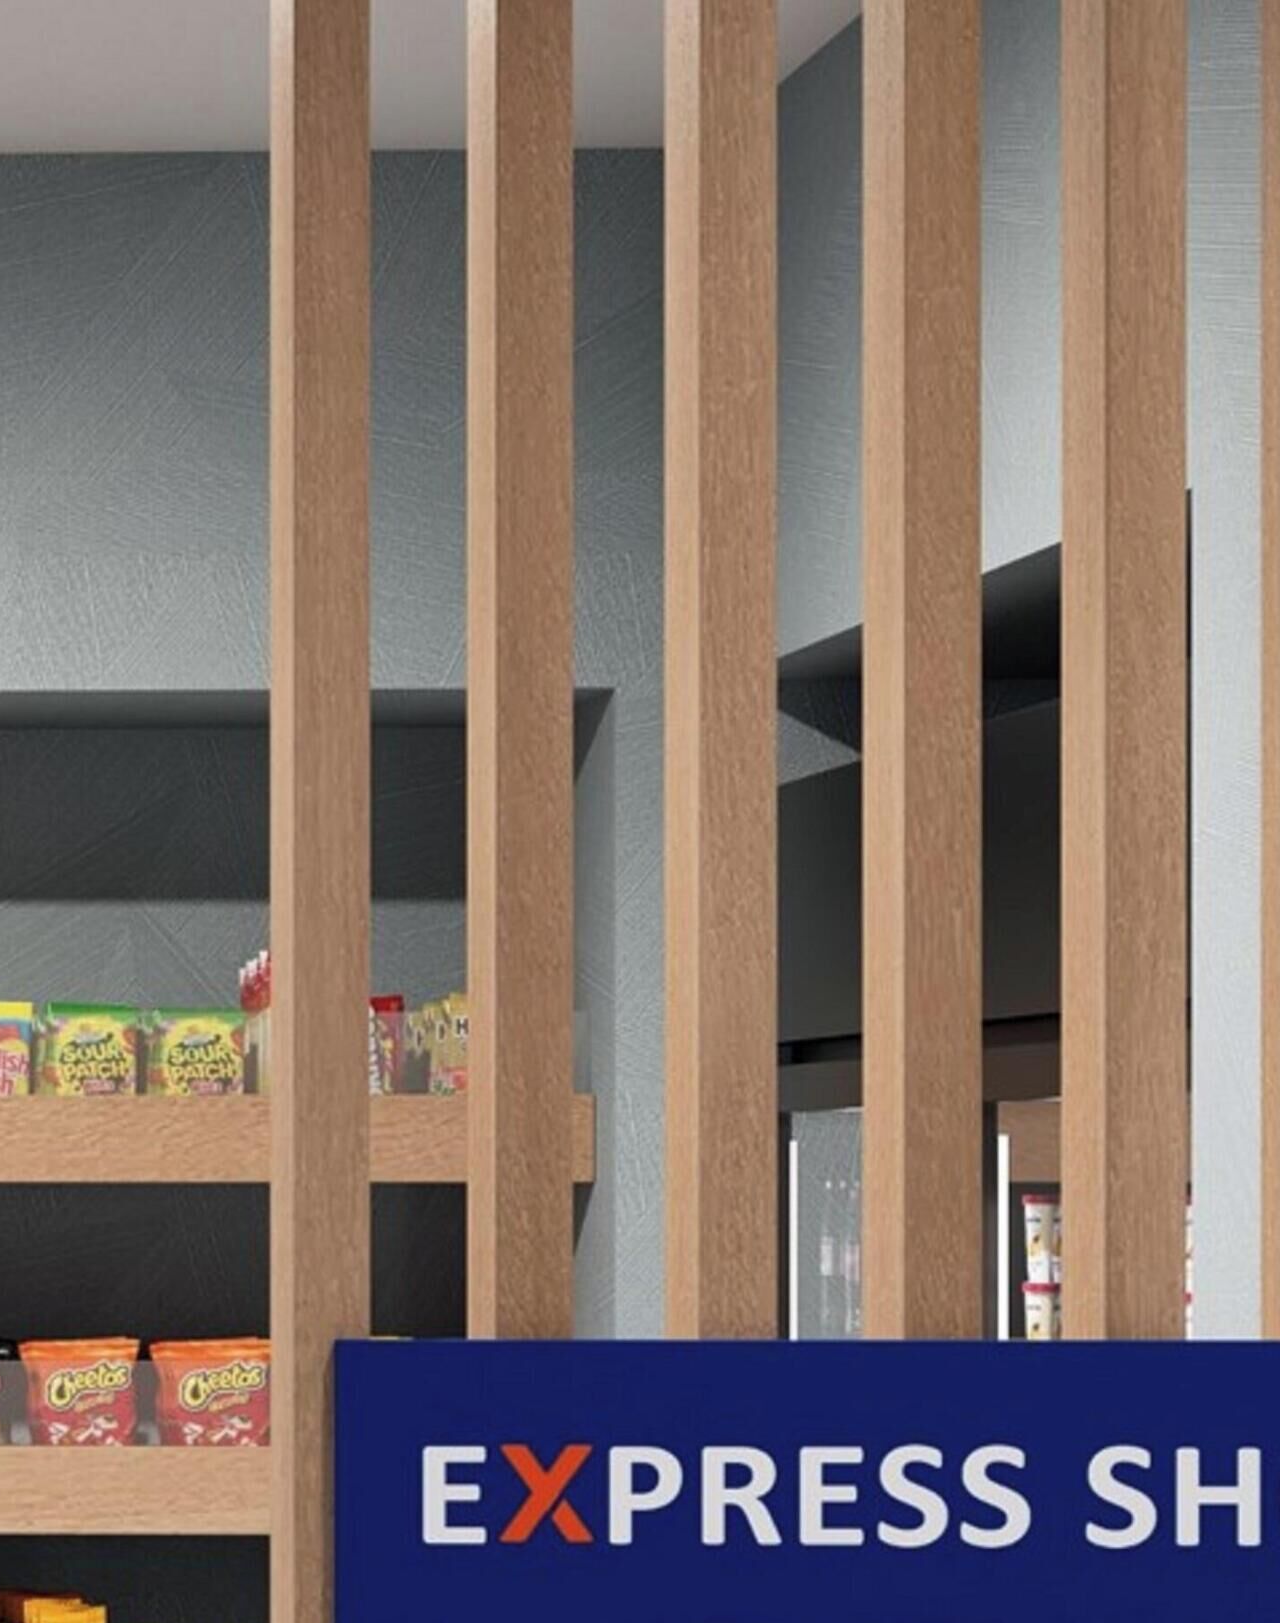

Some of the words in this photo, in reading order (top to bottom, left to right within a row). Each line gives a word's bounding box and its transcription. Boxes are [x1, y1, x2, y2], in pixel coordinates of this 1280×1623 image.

[47, 1363, 130, 1409] Cheetos
[182, 1363, 265, 1409] Cheetos
[421, 1444, 1032, 1547] EXPRESS
[1084, 1444, 1262, 1547] SH
